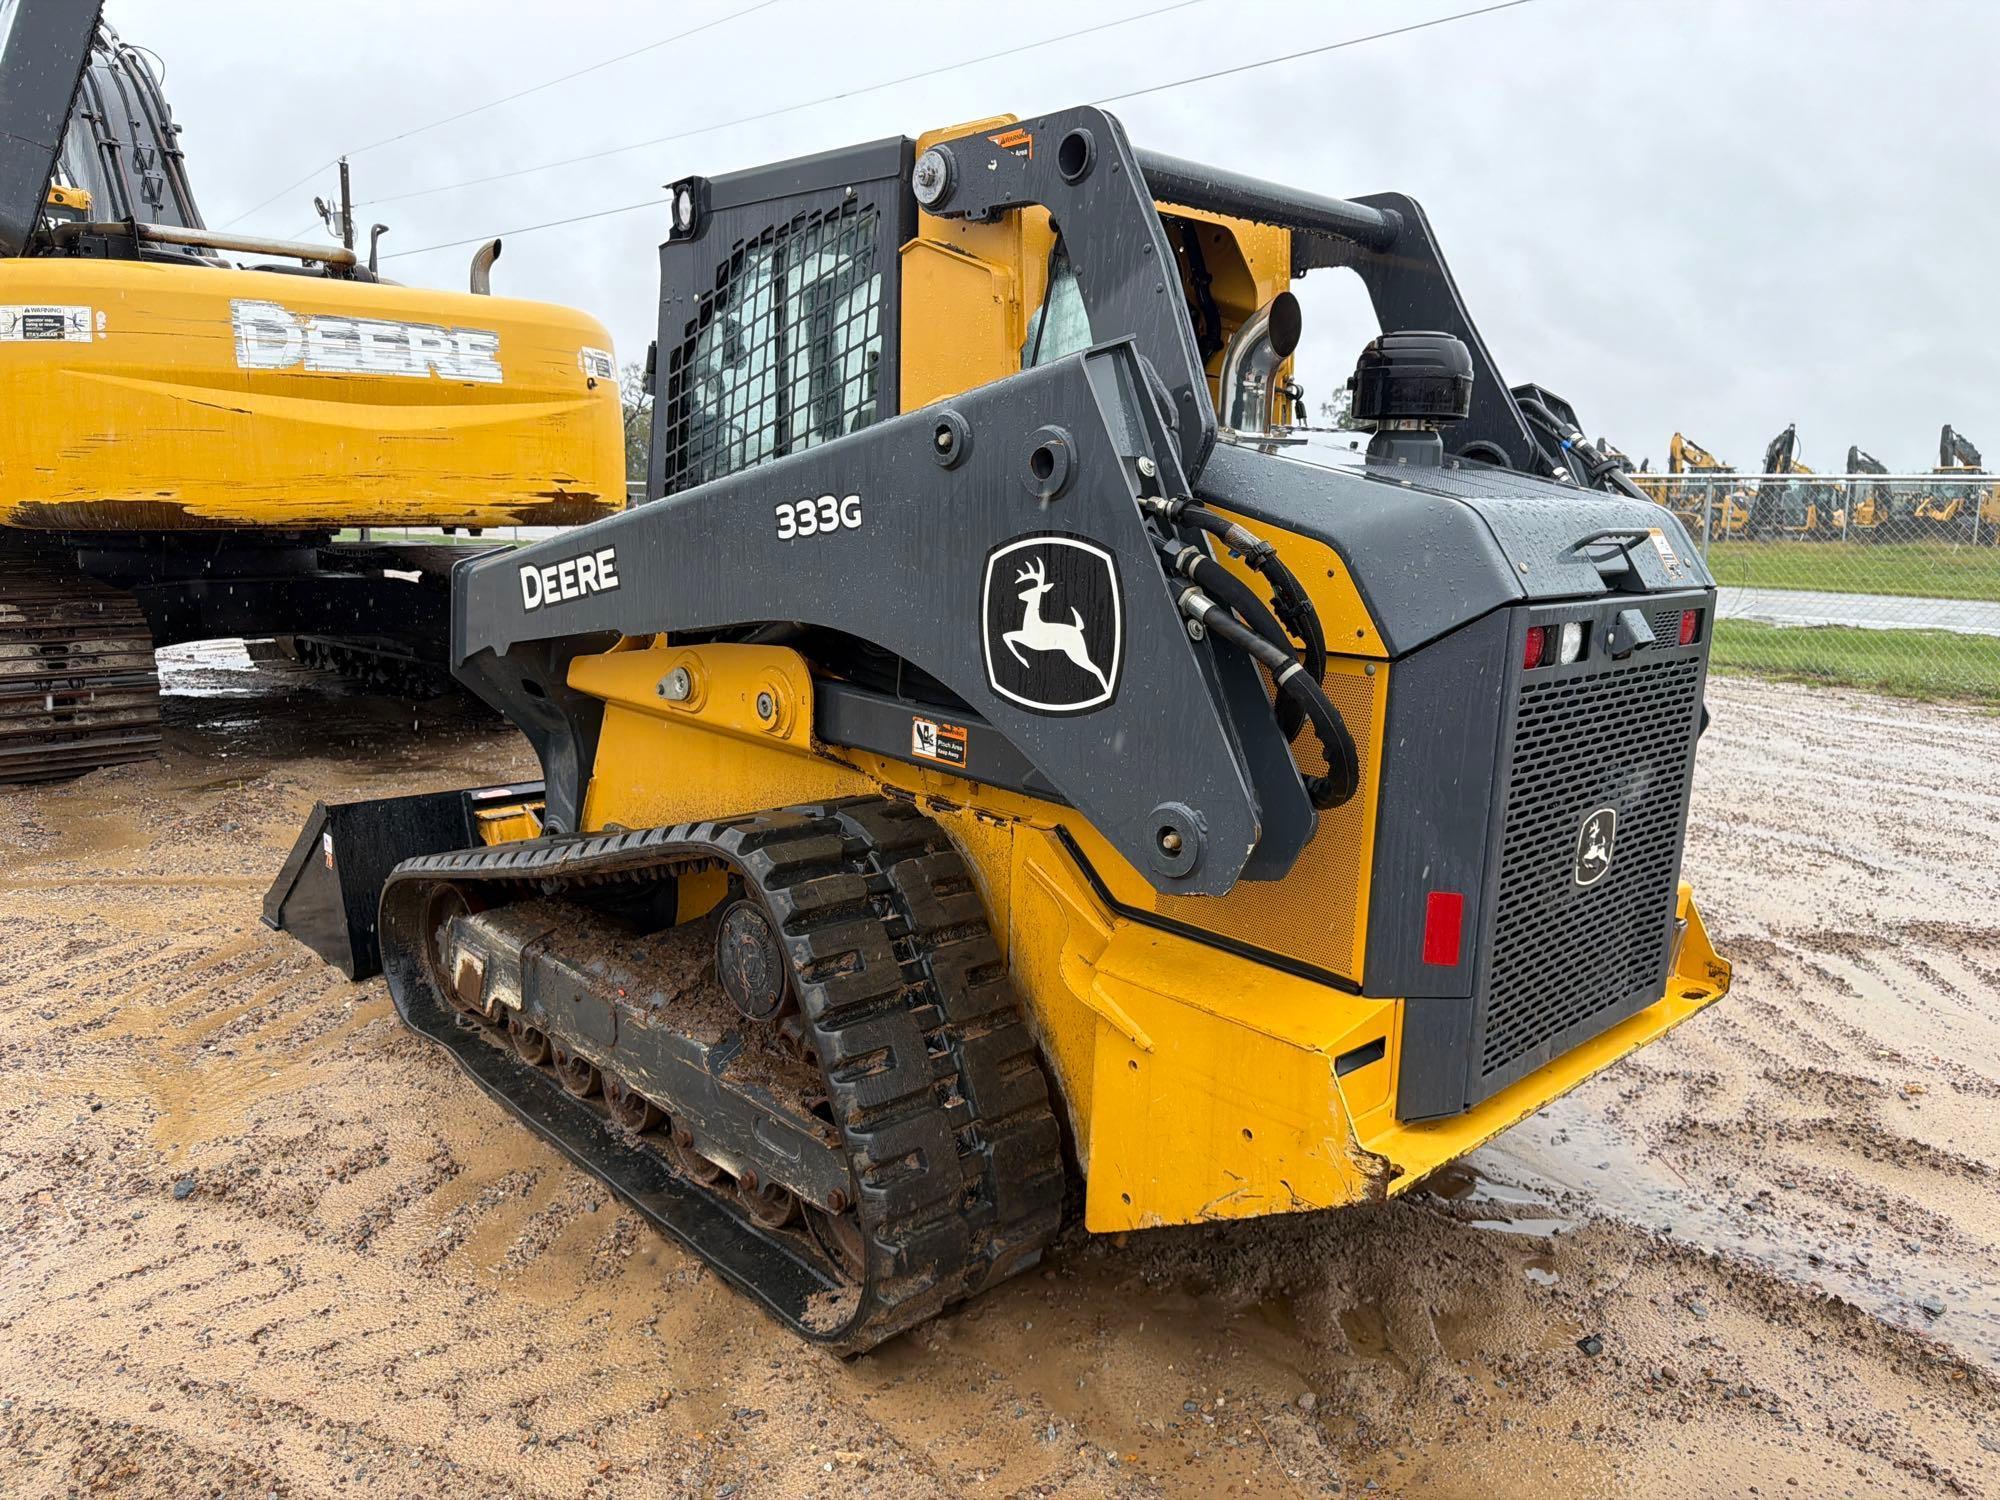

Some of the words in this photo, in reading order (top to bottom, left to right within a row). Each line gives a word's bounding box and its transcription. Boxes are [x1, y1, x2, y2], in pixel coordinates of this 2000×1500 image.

[230, 299, 503, 384] DEERE
[775, 495, 862, 539] 333G
[519, 548, 619, 610] DEERE
